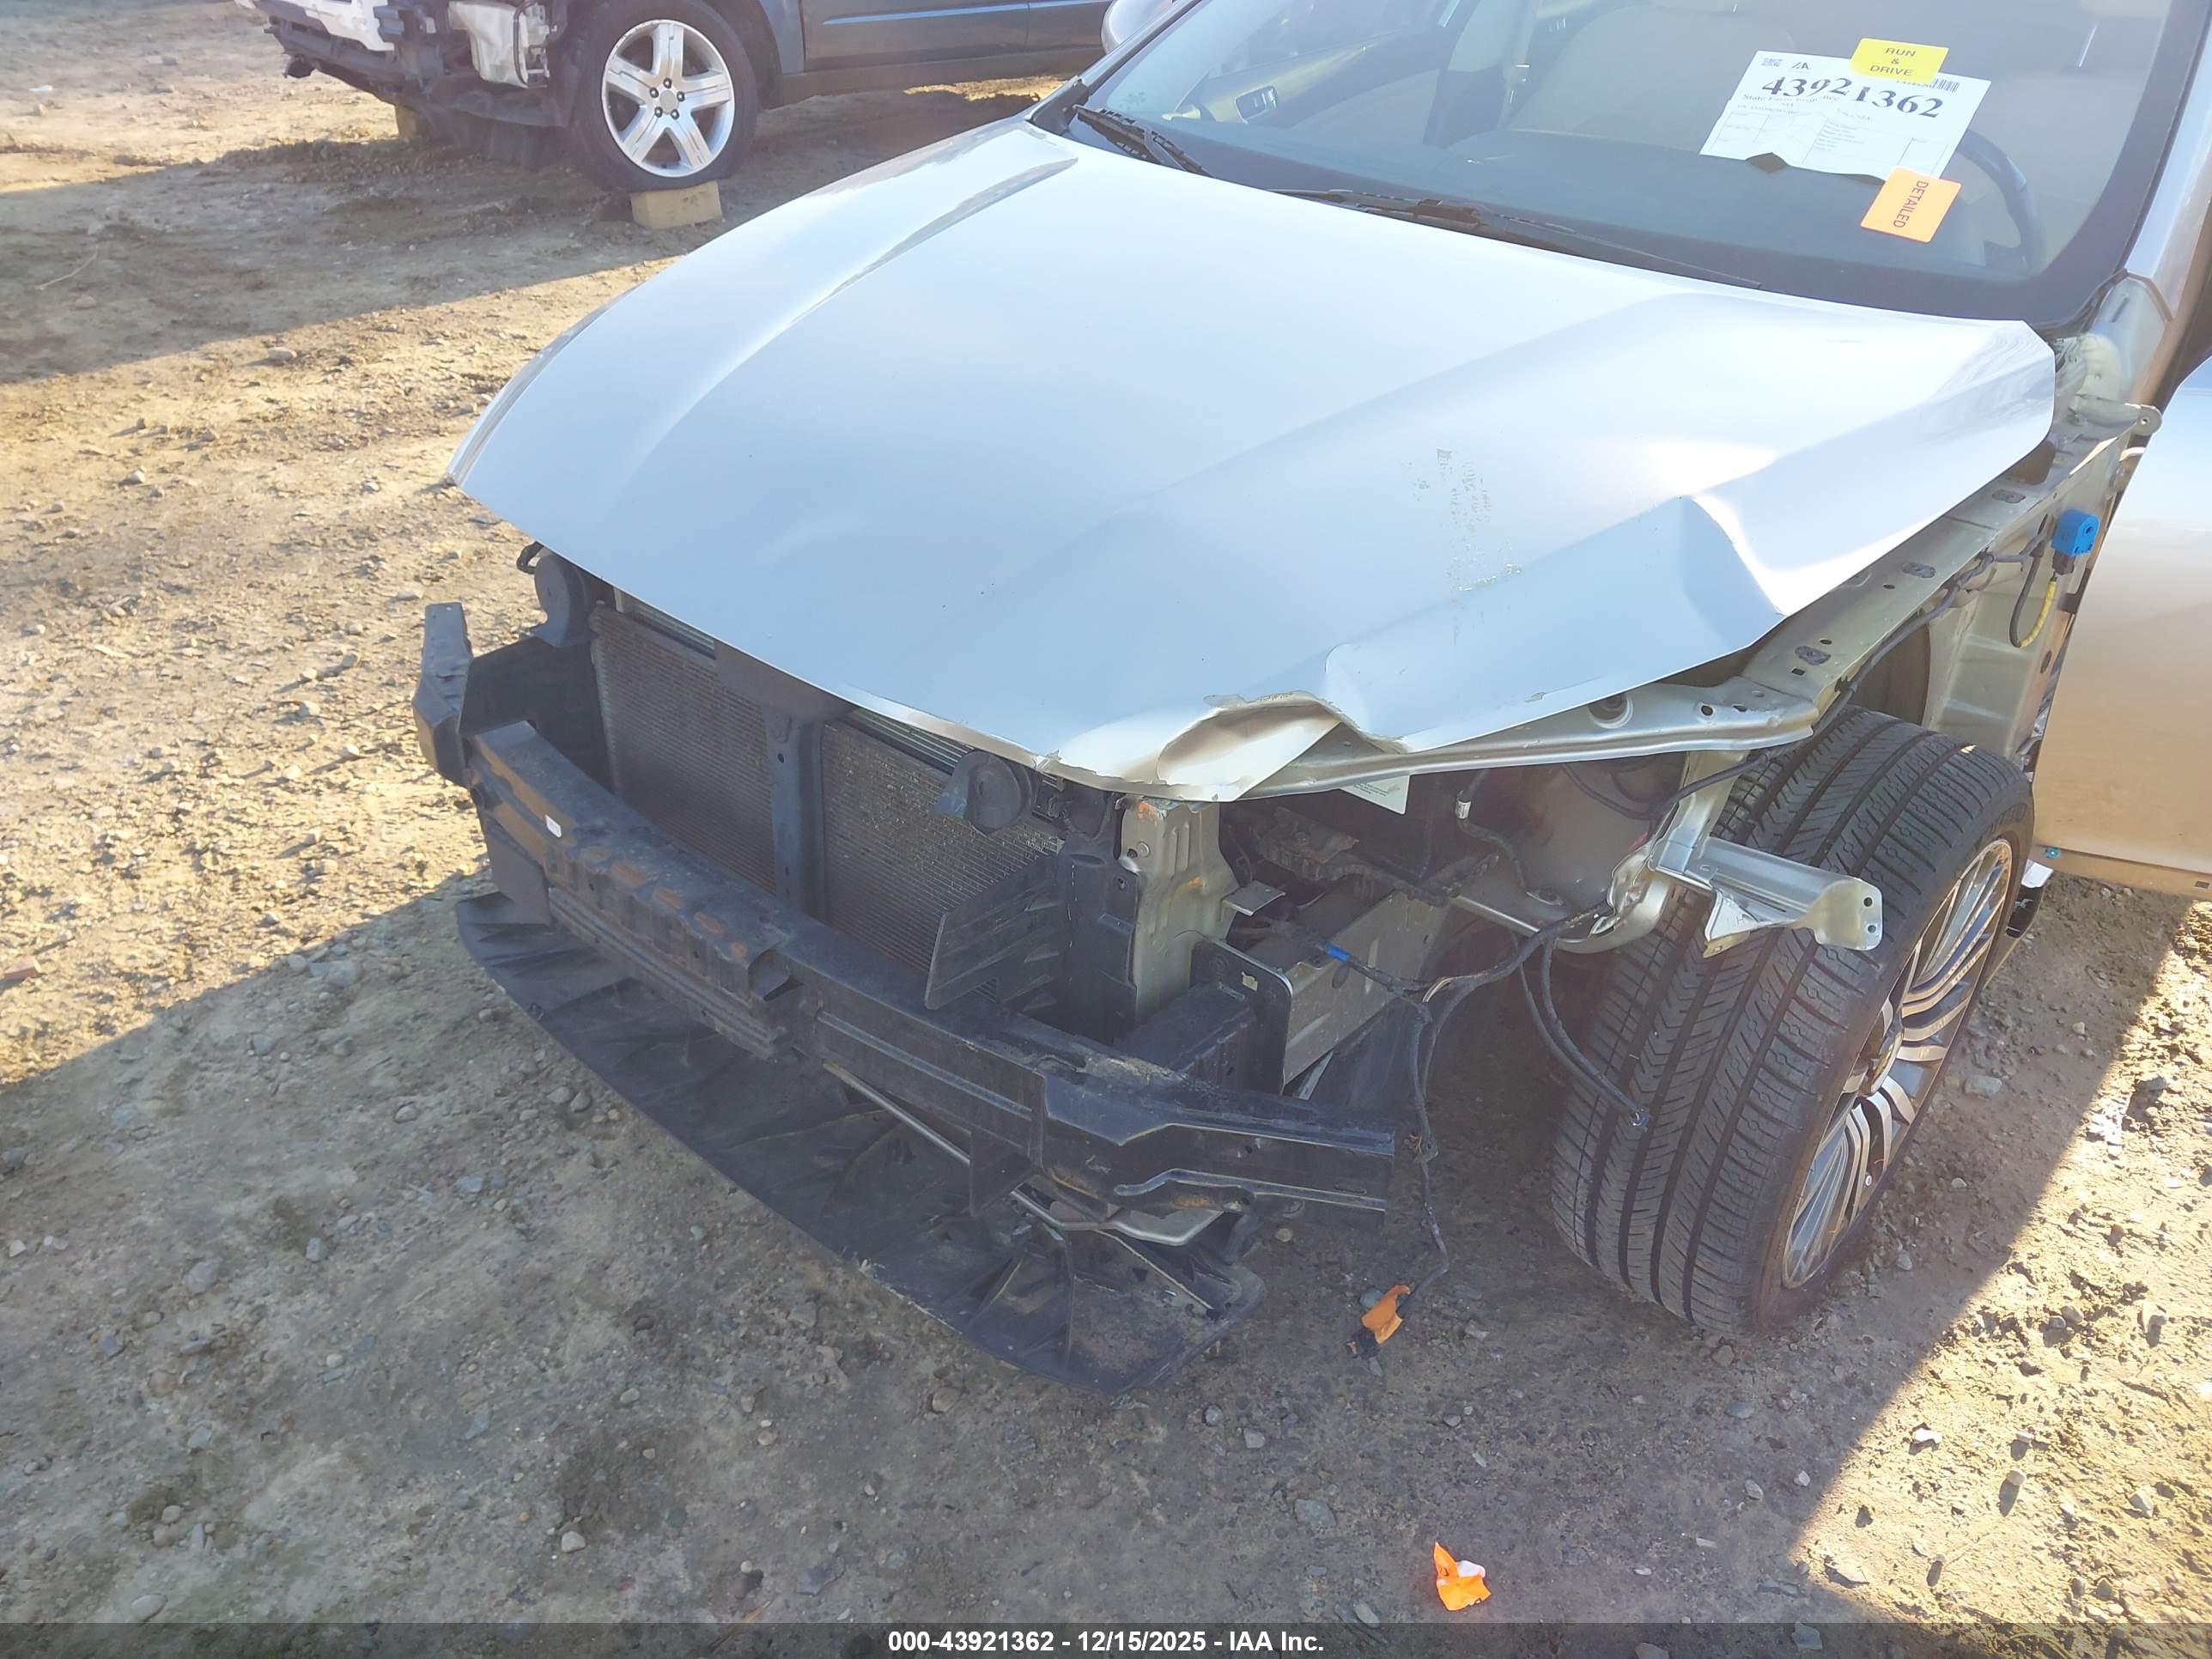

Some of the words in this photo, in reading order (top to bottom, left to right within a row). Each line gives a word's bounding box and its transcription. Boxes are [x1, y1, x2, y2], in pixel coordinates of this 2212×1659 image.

[1885, 47, 1916, 57] RUN
[1869, 64, 1914, 76] DRIVE
[1761, 76, 1944, 118] 43921362
[1893, 179, 1929, 228] DETAILED
